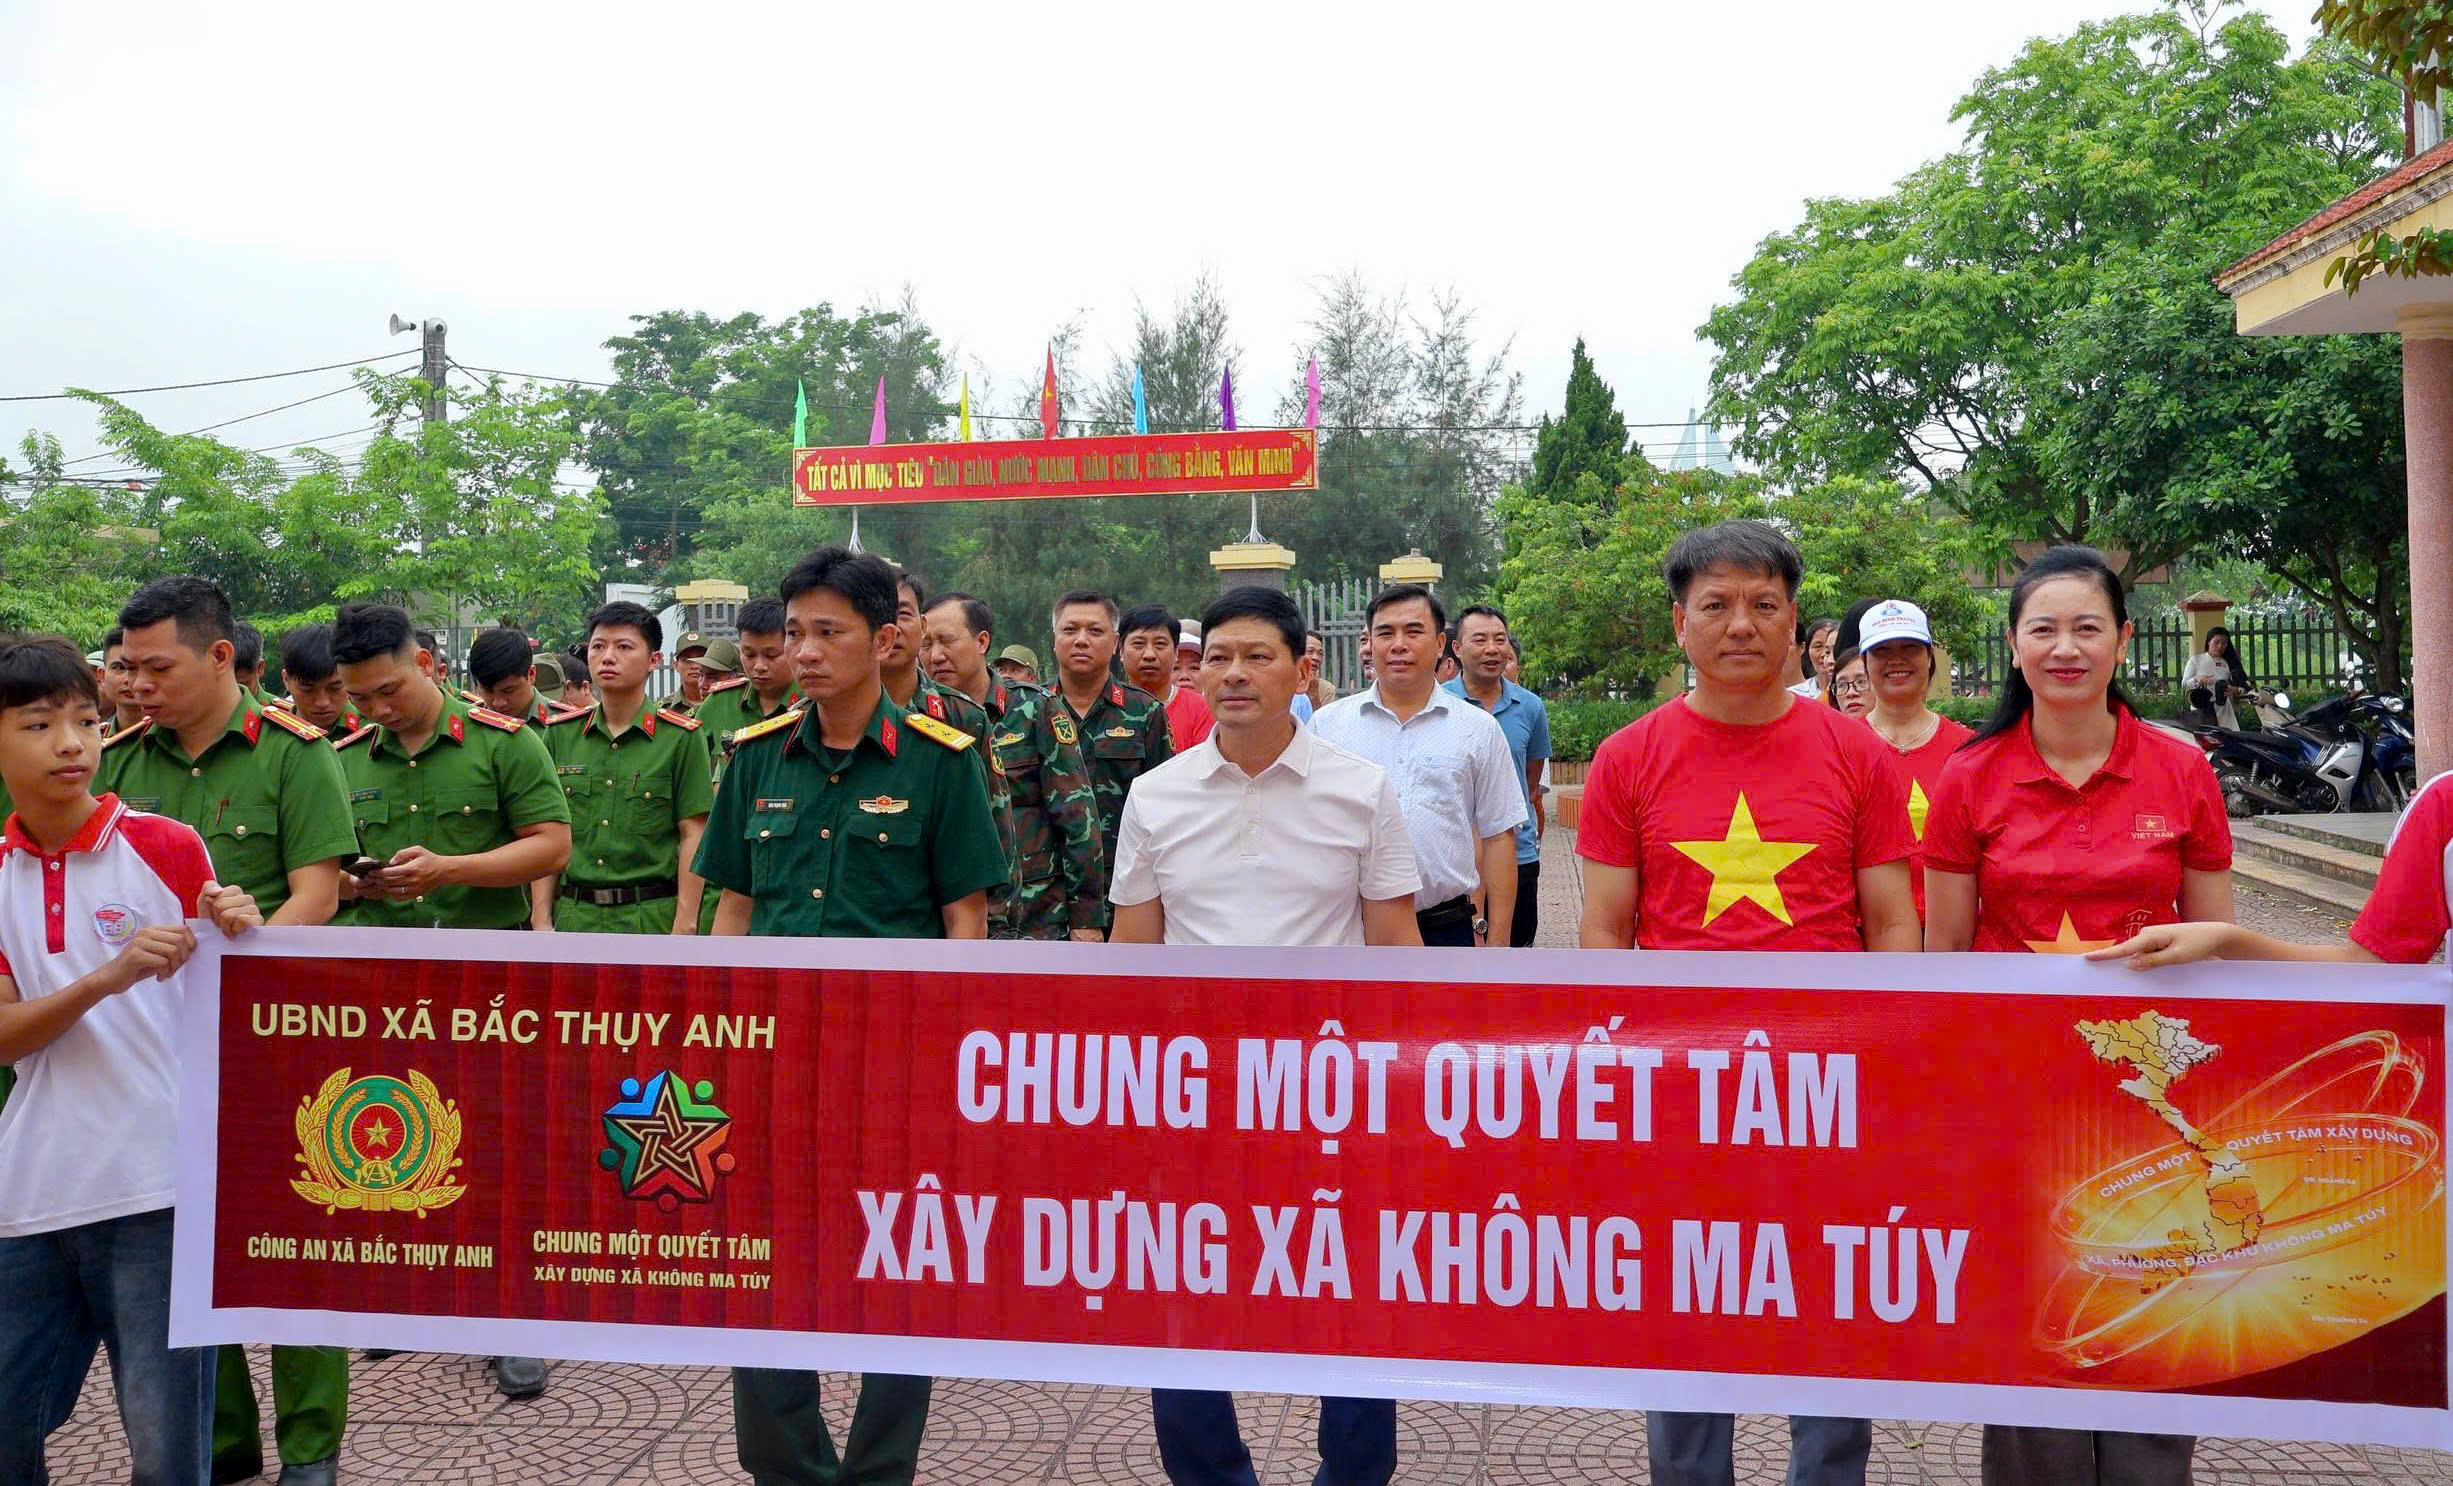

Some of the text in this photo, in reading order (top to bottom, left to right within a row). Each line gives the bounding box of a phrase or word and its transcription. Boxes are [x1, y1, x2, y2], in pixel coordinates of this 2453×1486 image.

[807, 456, 828, 491] TẤT
[830, 456, 847, 490] CẢ
[849, 459, 862, 490] VÌ
[864, 463, 893, 492] MỤC
[896, 458, 924, 488] TIÊU
[997, 452, 1033, 484] NƯỚC
[1081, 450, 1109, 482] DÂN
[1146, 447, 1181, 479] CÔNG
[1185, 443, 1224, 479] BẰNG,
[1227, 444, 1254, 477] VĂN
[253, 993, 776, 1053] UBND XÃ BẮC THỤY ANH
[957, 1015, 1857, 1155] CHUNG MỘT QUYẾT TÂM
[2100, 1166, 2156, 1197] CHUNG
[2226, 1128, 2281, 1149] QUYẾT
[2286, 1126, 2322, 1140] TÂM
[2327, 1124, 2358, 1140] XÂY
[2362, 1126, 2413, 1146] DỰNG
[248, 1232, 493, 1269] CÔNG AN XÃ BẮC THỤY ANH
[533, 1229, 771, 1261] CHUNG MỘT QUYẾT TÂM
[856, 1173, 1970, 1324] XÂY DỰNG XÃ KHÔNG MA TÚY
[2328, 1220, 2354, 1235] MA
[534, 1264, 771, 1290] XÂY DỰNG XÃ KHÔNG MA TÚY
